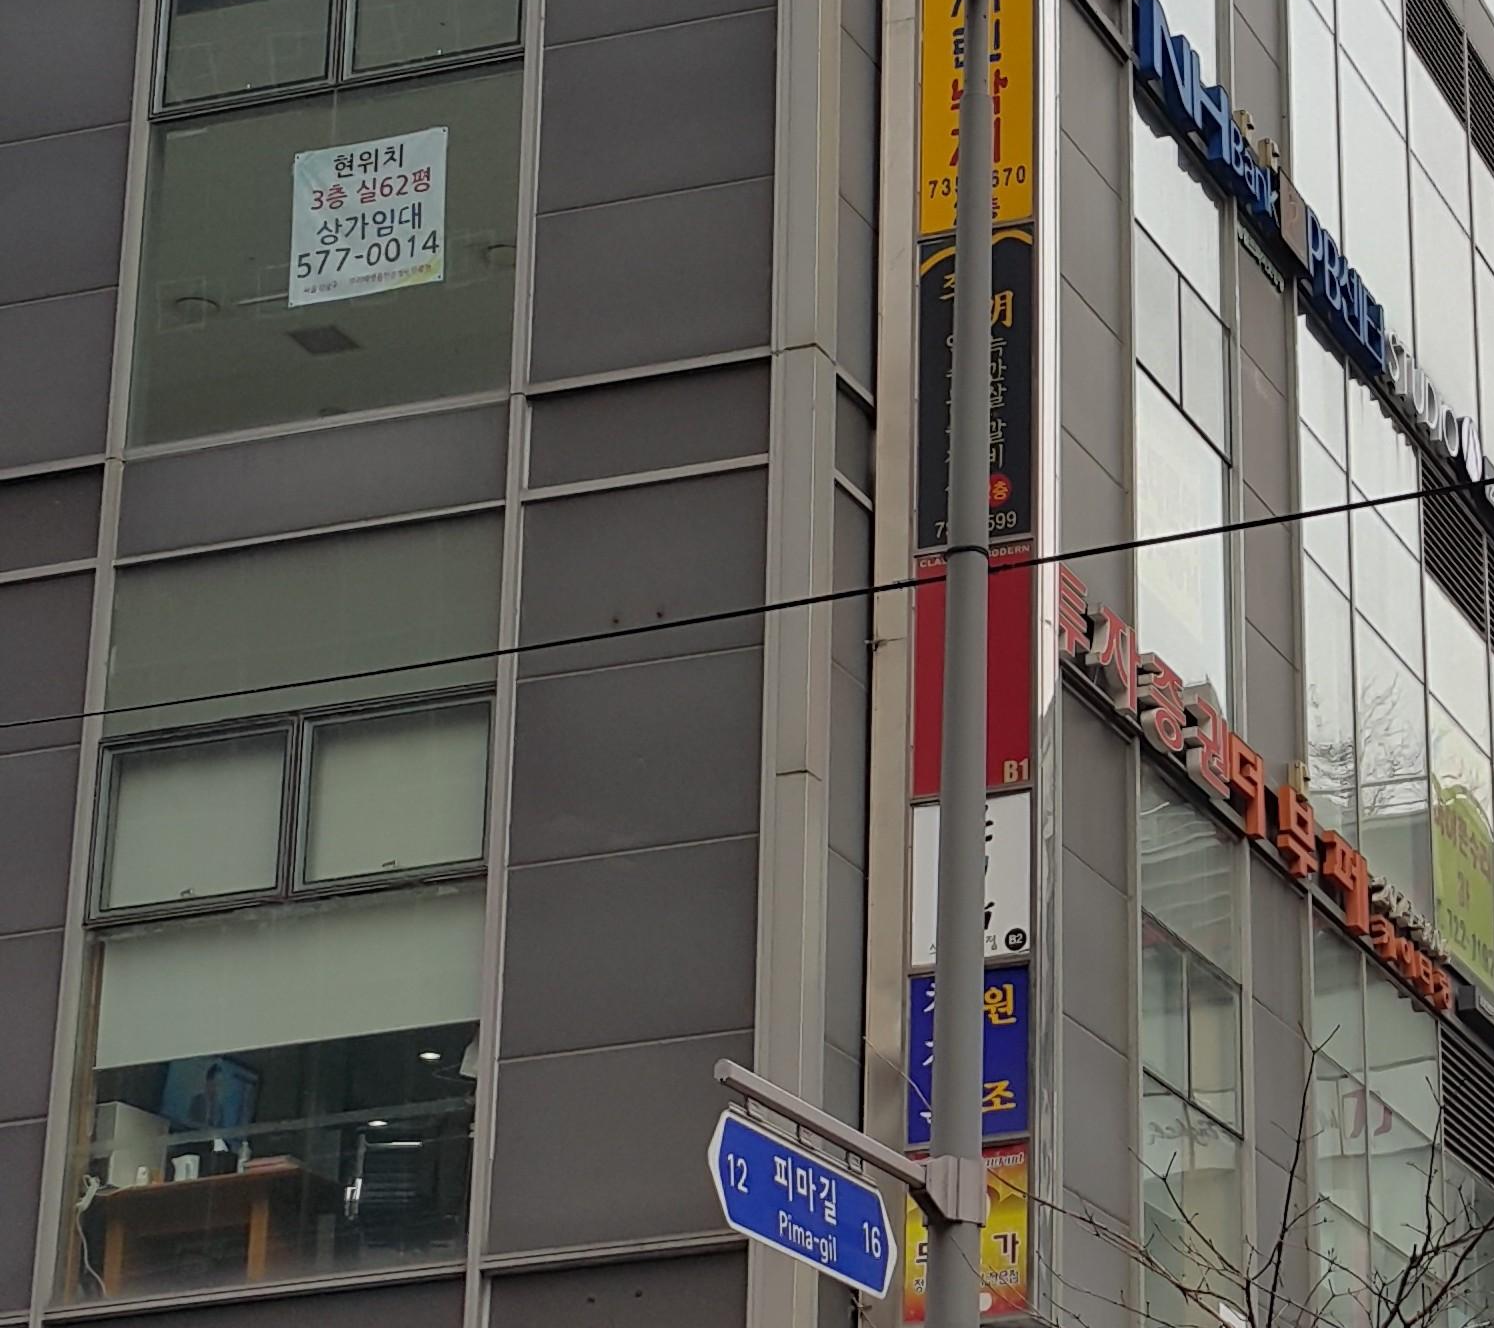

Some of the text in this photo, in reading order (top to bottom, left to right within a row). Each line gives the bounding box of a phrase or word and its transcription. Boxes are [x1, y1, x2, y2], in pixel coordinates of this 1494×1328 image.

[333, 143, 404, 179] 현위치
[310, 166, 431, 211] 3층 실62평
[316, 201, 422, 247] 상가임대
[296, 229, 440, 279] 577-0014
[1385, 328, 1460, 460] STUDIO
[1058, 561, 1231, 801] 투자증권
[1003, 756, 1029, 784] B1
[1008, 931, 1024, 947] B2
[727, 1152, 749, 1194] 12
[773, 1154, 838, 1226] 피마길
[778, 1210, 838, 1263] Pima-gil
[862, 1221, 882, 1260] 16
